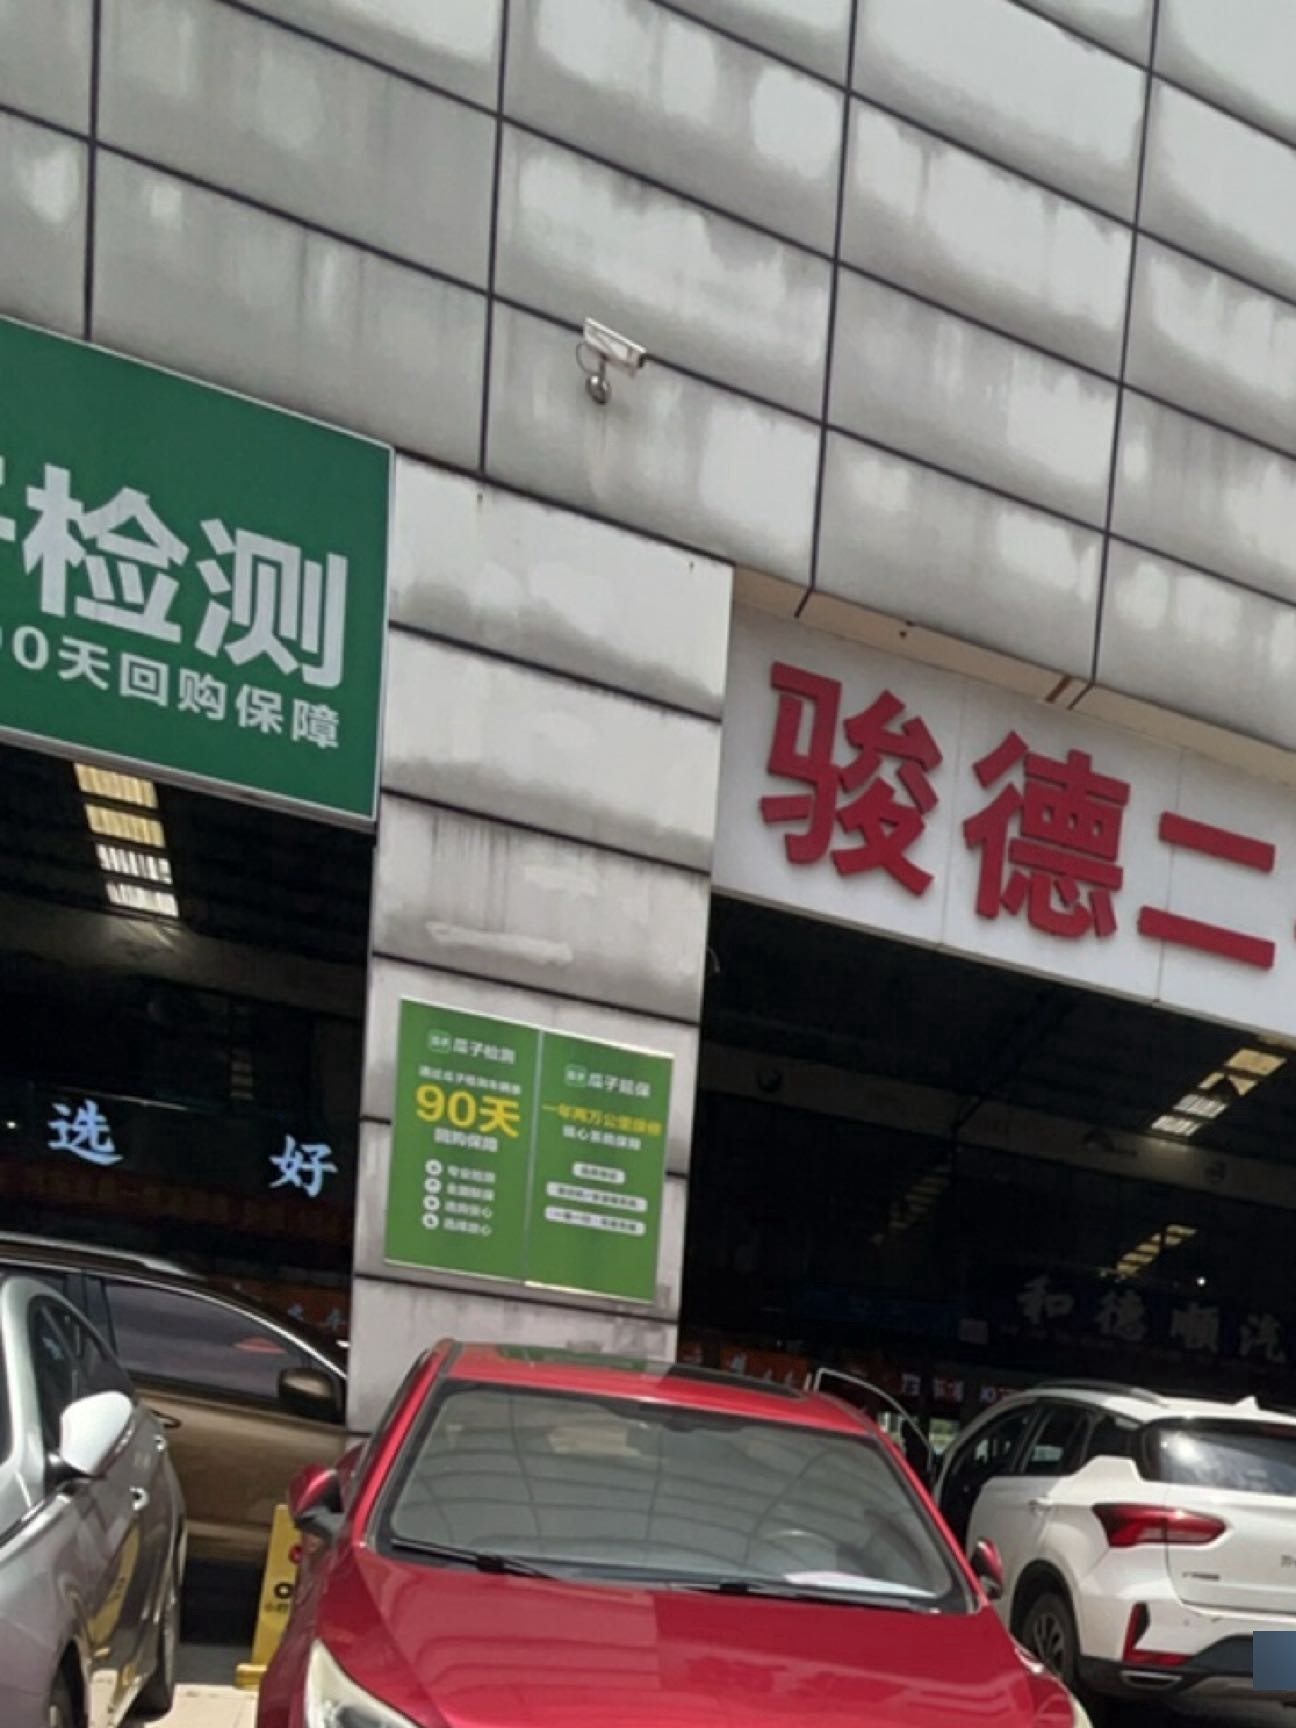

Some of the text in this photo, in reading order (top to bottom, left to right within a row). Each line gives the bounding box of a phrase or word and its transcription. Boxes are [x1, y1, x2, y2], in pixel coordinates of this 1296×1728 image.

[0, 455, 349, 689] 检测
[0, 624, 341, 750] 0天回购保障
[47, 1098, 339, 1198] 选 好
[415, 1083, 521, 1139] 90天
